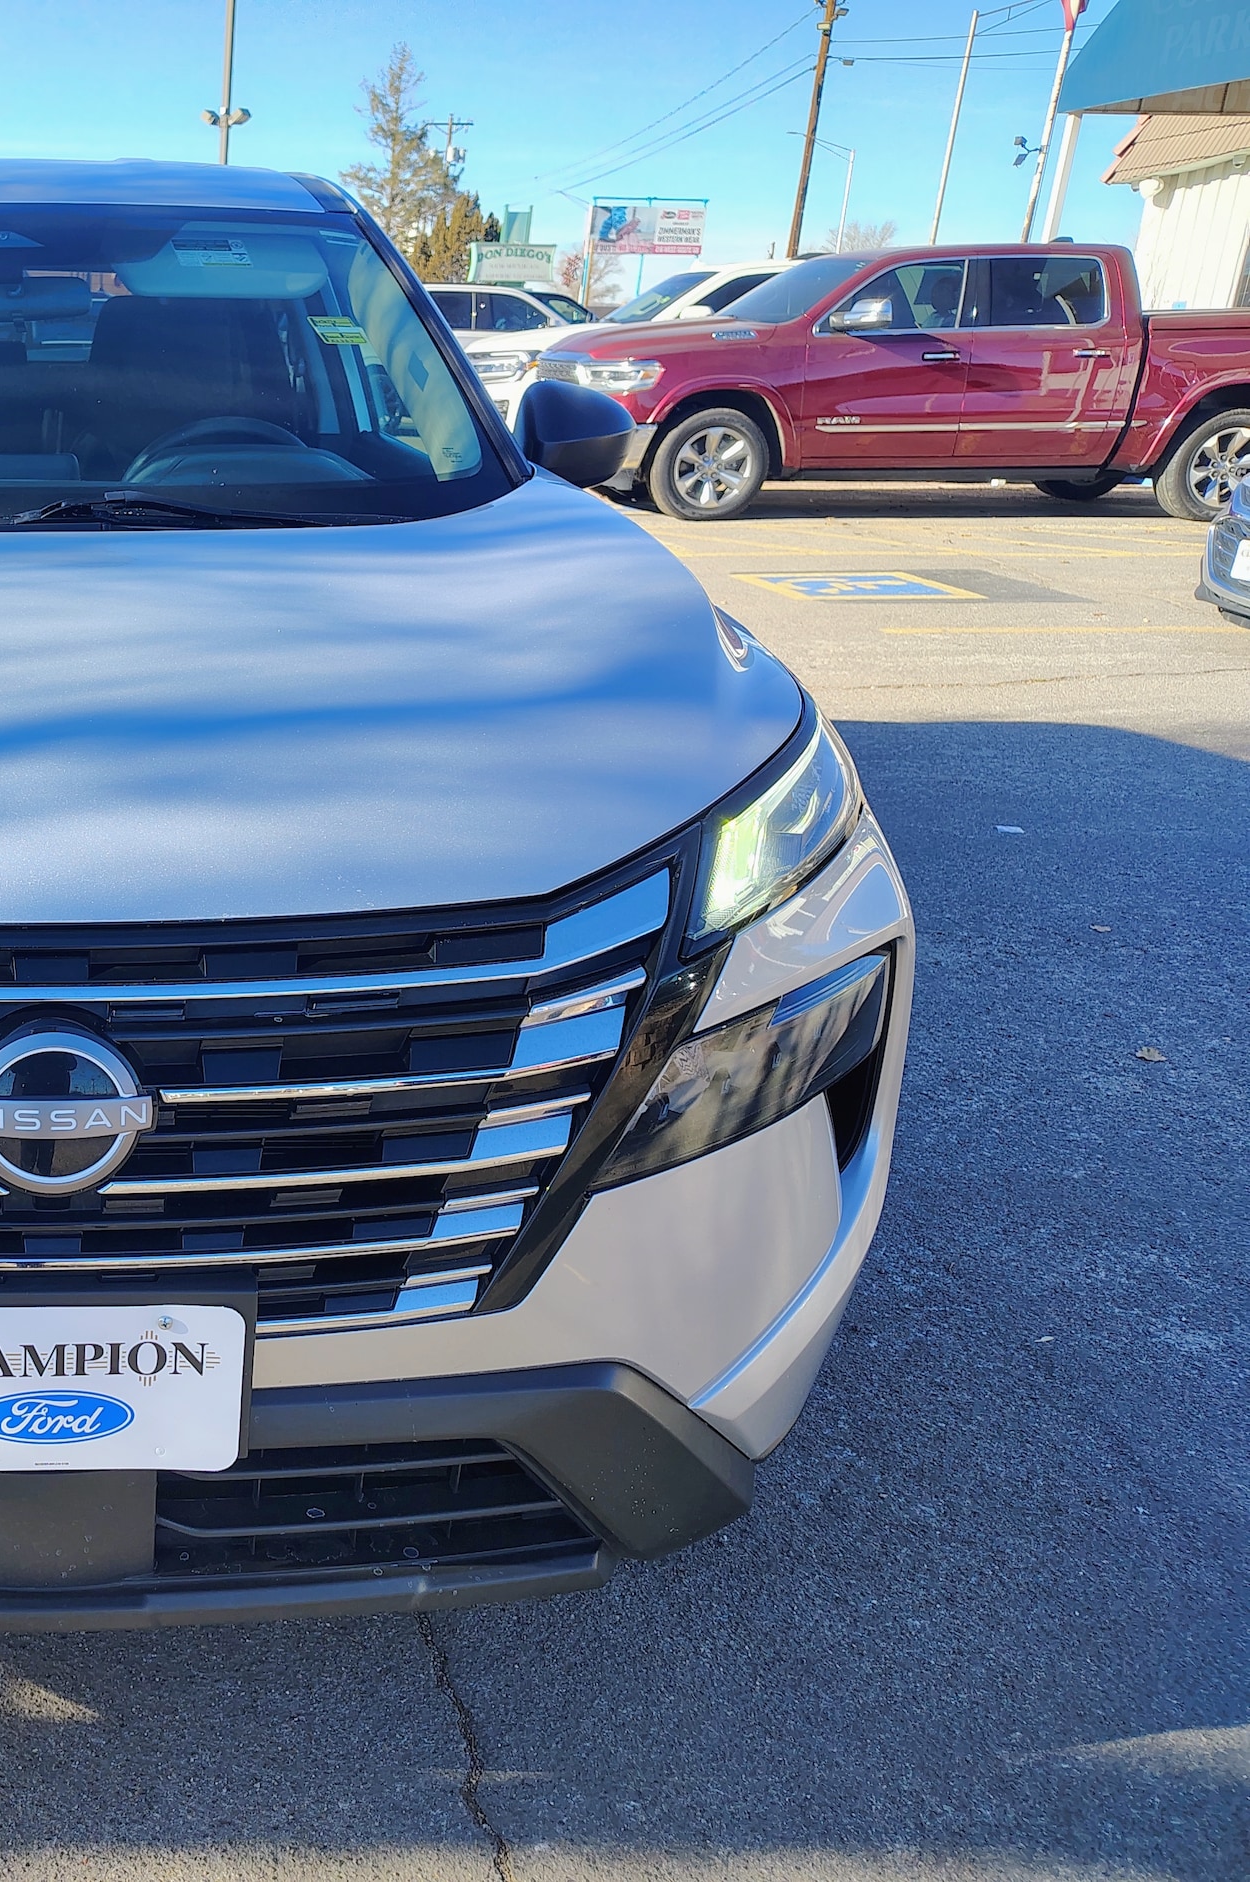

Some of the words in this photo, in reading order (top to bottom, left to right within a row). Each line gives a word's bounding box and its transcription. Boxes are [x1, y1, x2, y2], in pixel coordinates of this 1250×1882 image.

[478, 249, 502, 263] DON
[506, 247, 552, 264] DIEGO'S
[816, 415, 862, 425] RAM
[0, 1398, 105, 1436] Ford
